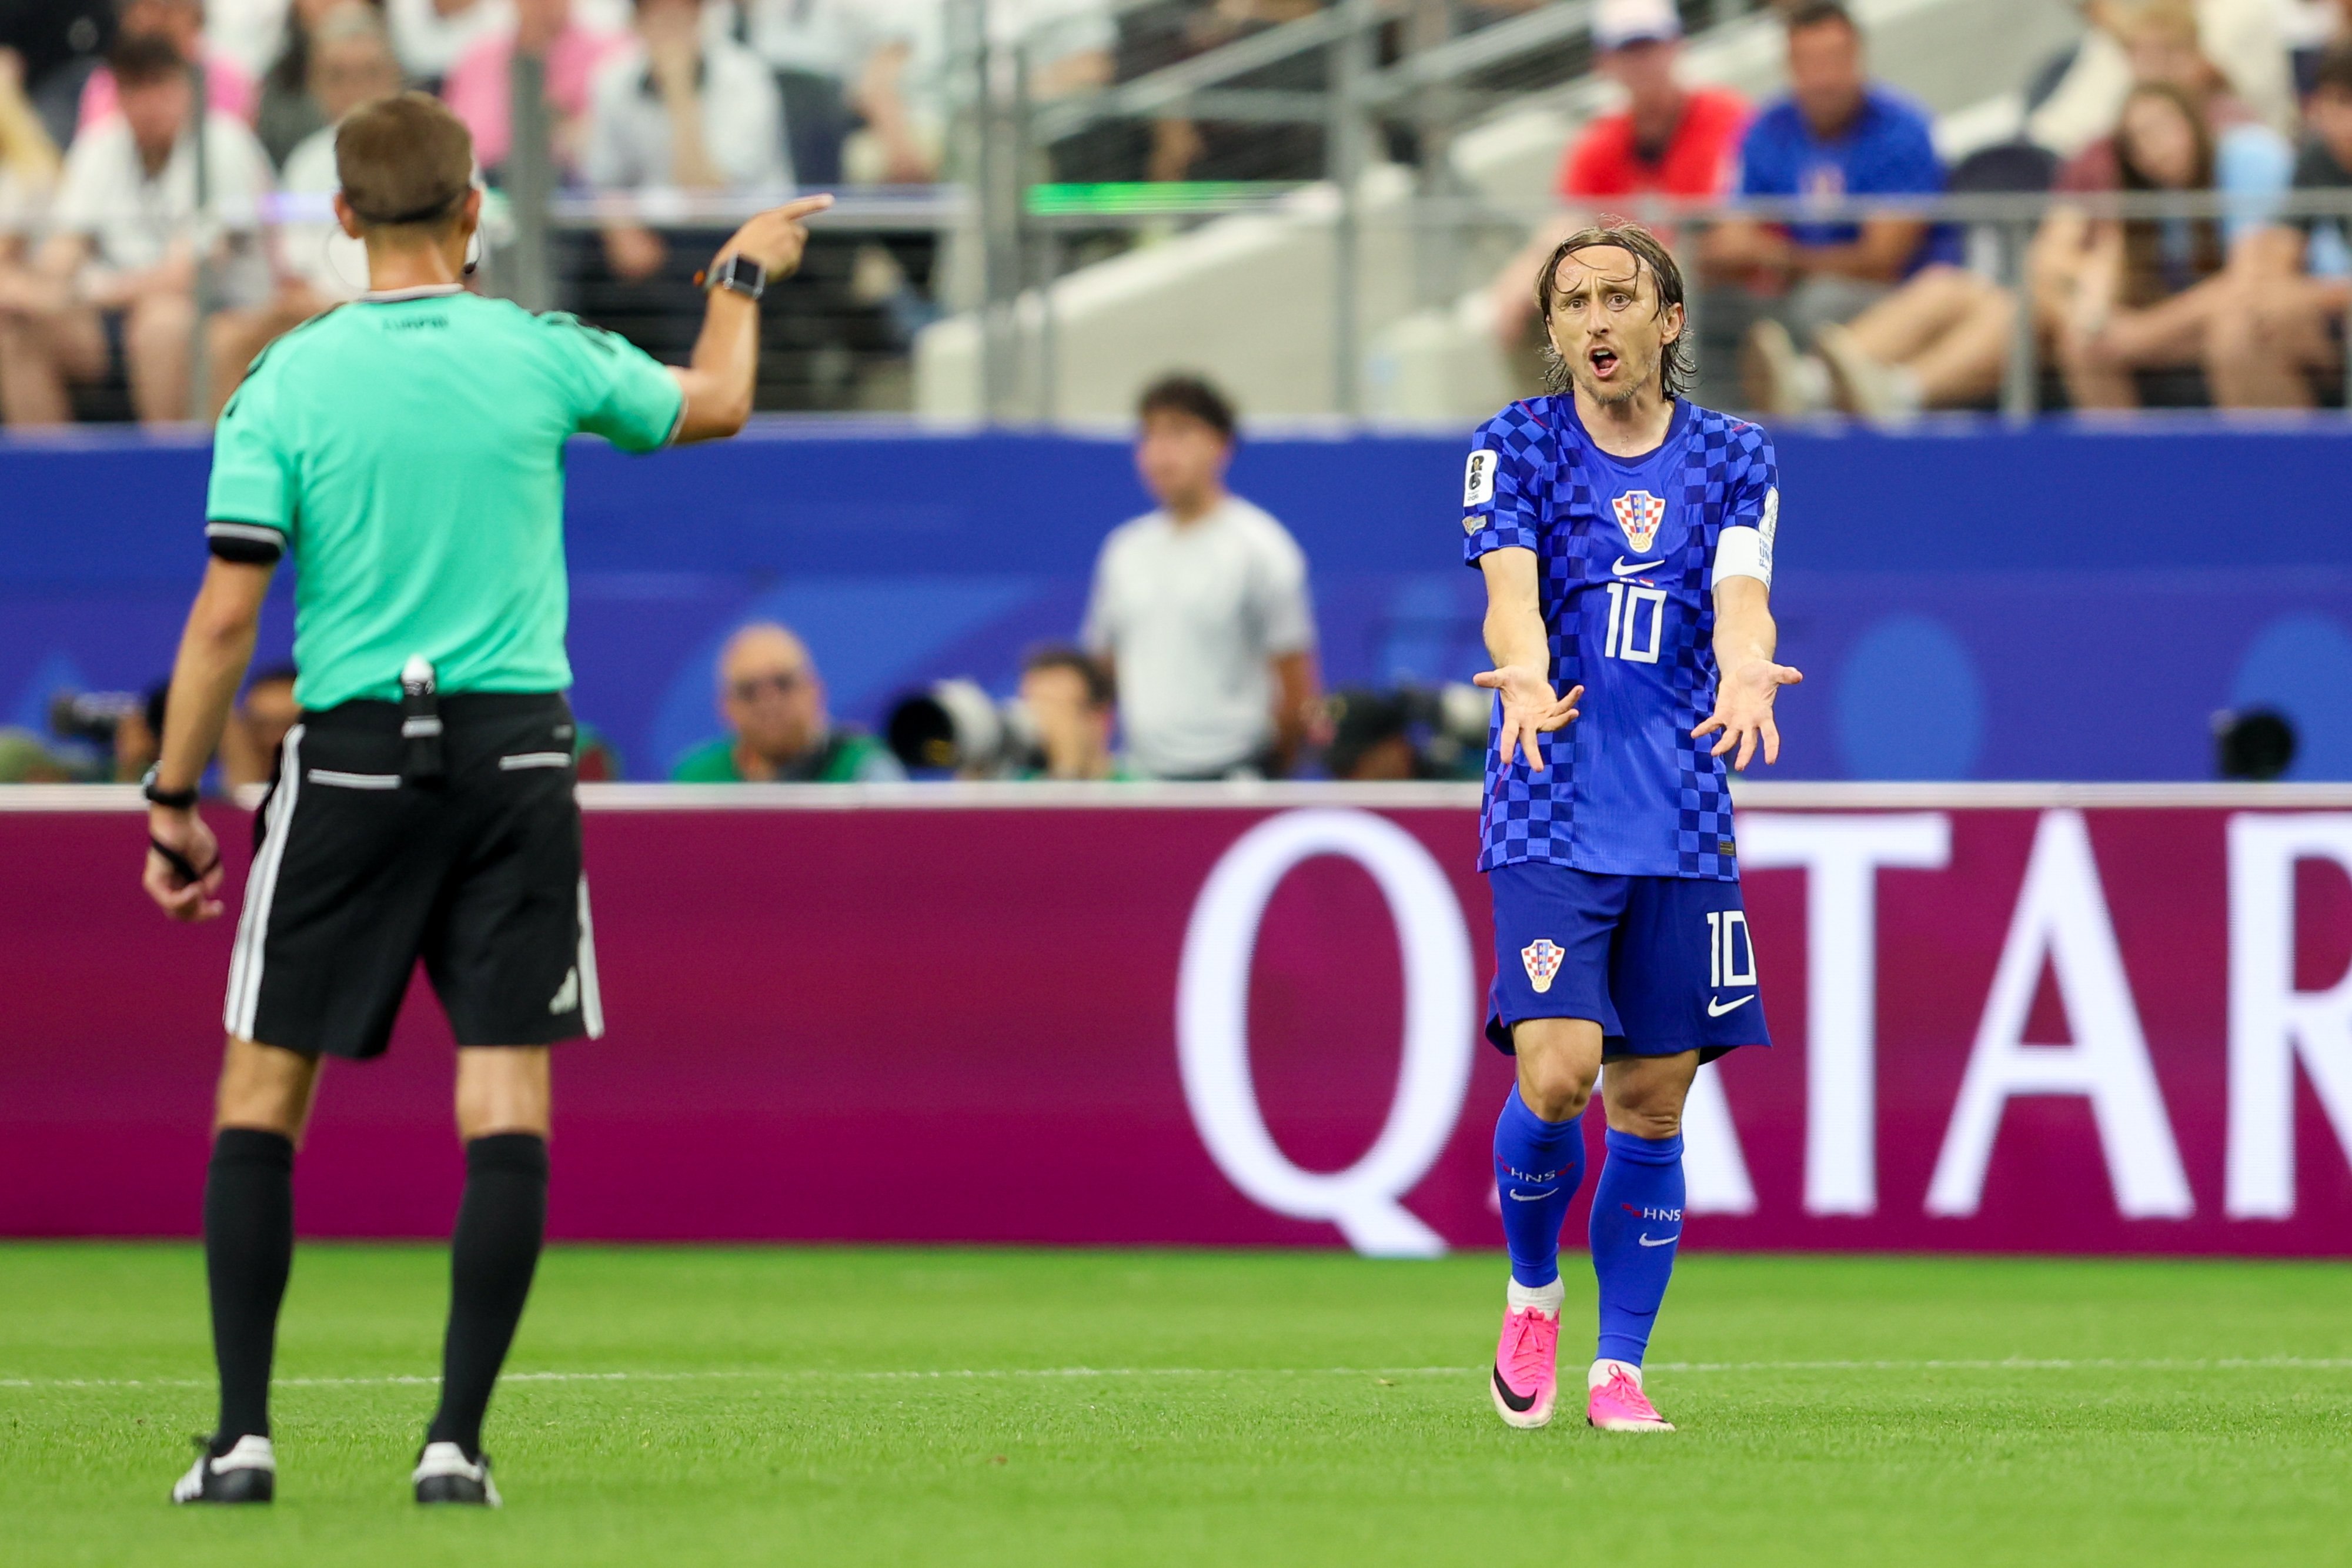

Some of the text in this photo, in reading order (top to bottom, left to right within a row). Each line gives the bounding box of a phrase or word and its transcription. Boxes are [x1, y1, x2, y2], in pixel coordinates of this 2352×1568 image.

[1634, 497, 1643, 527] HNS
[1605, 582, 1667, 664] 10
[1706, 911, 1757, 987] 10
[1511, 1167, 1555, 1183] HNS
[1643, 1208, 1681, 1222] HNS
